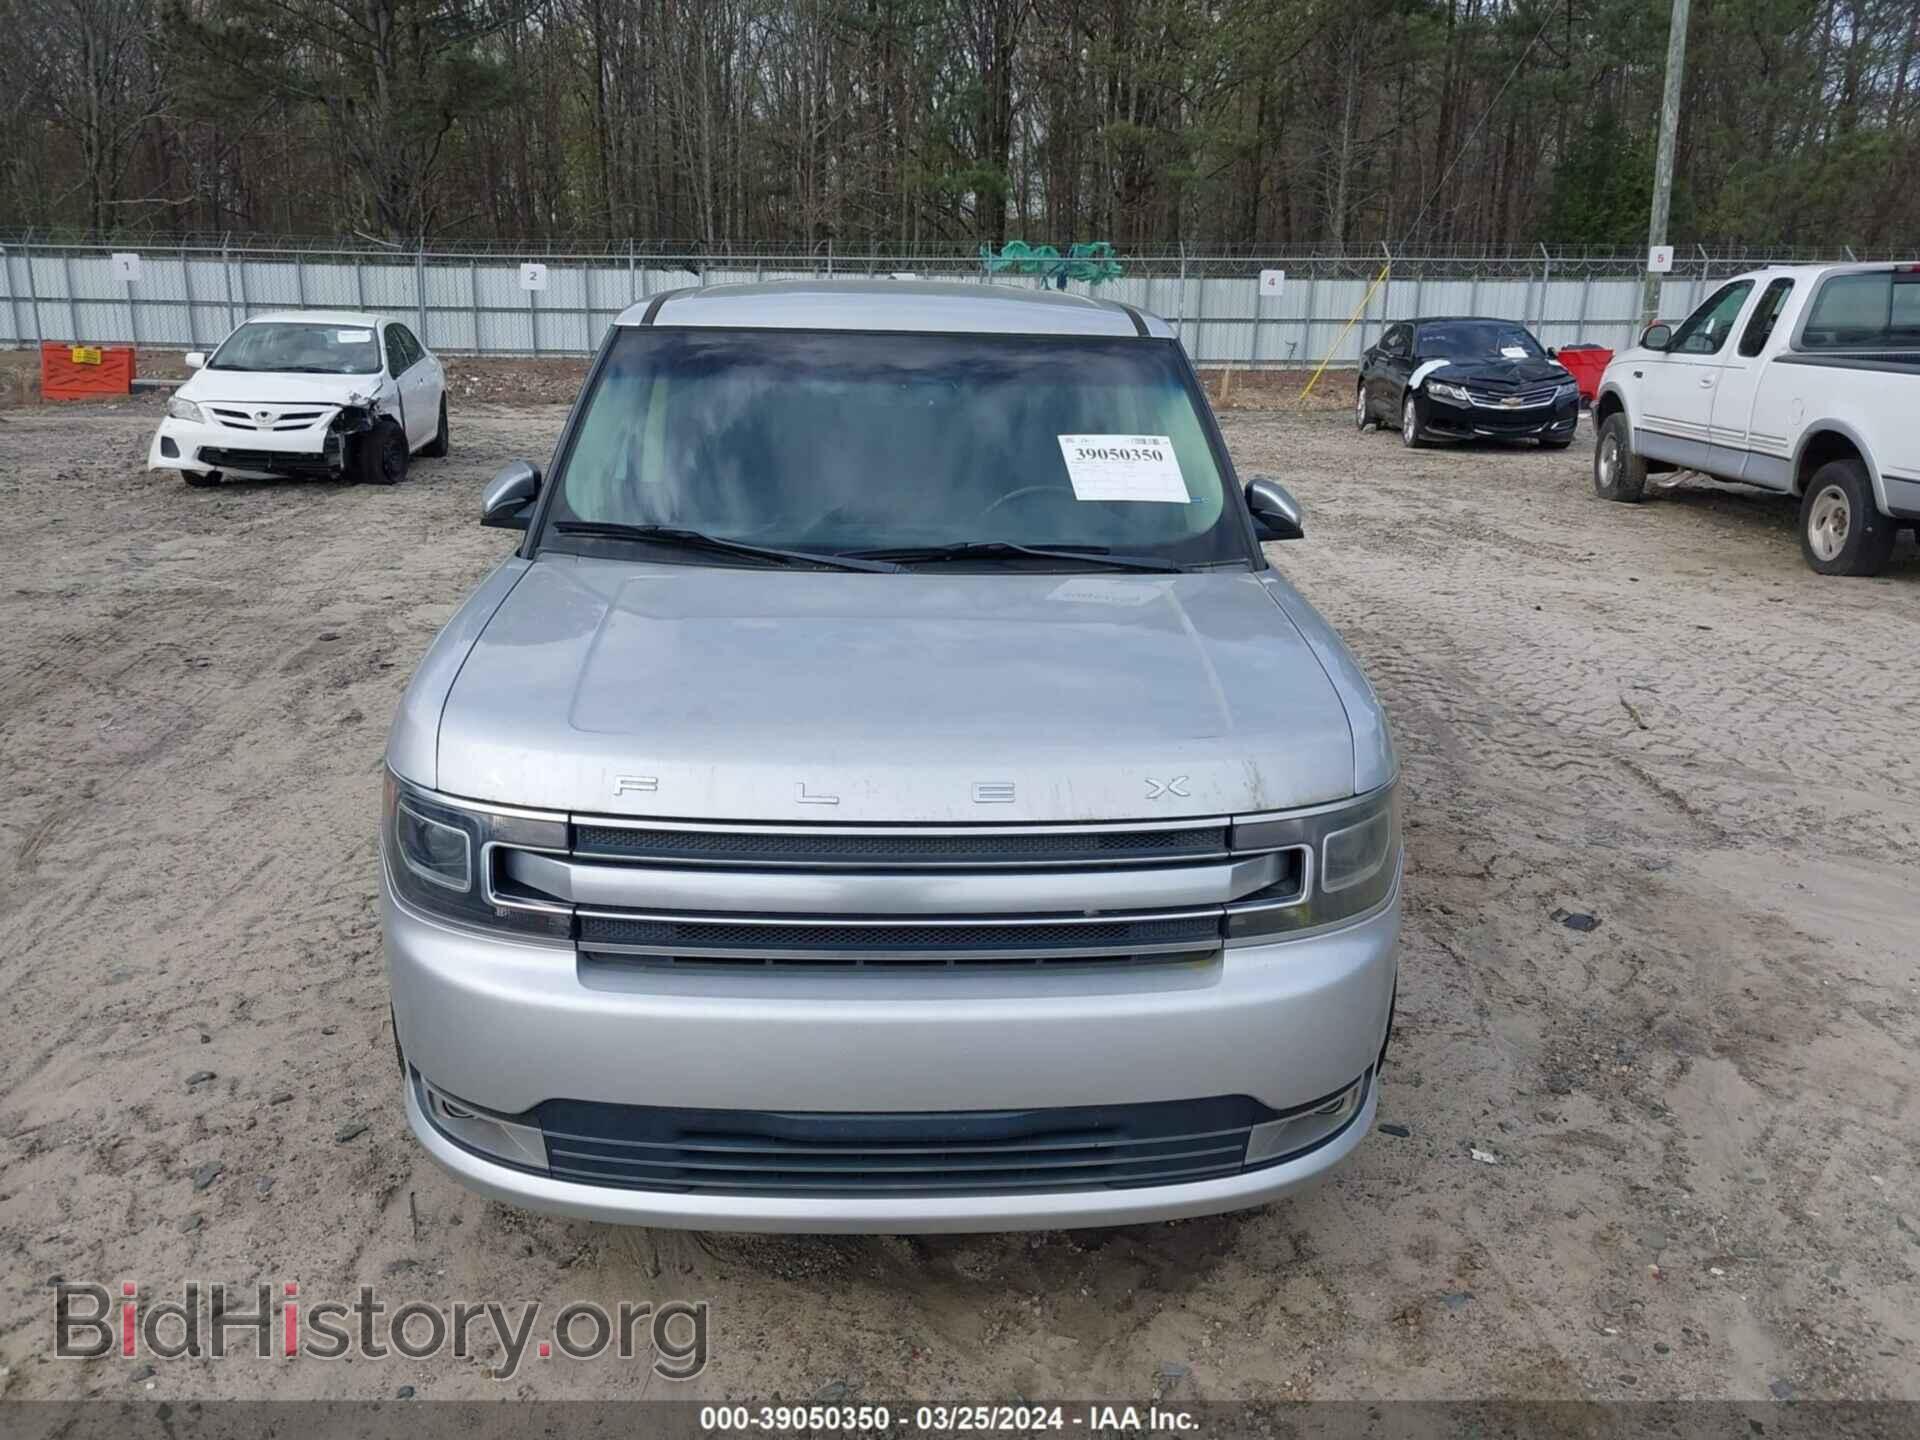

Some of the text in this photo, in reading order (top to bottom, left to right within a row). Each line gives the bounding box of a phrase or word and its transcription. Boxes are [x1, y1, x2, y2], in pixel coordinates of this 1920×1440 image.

[529, 271, 537, 281] 2
[1074, 447, 1164, 463] 39050350
[612, 774, 1190, 805] FLEX
